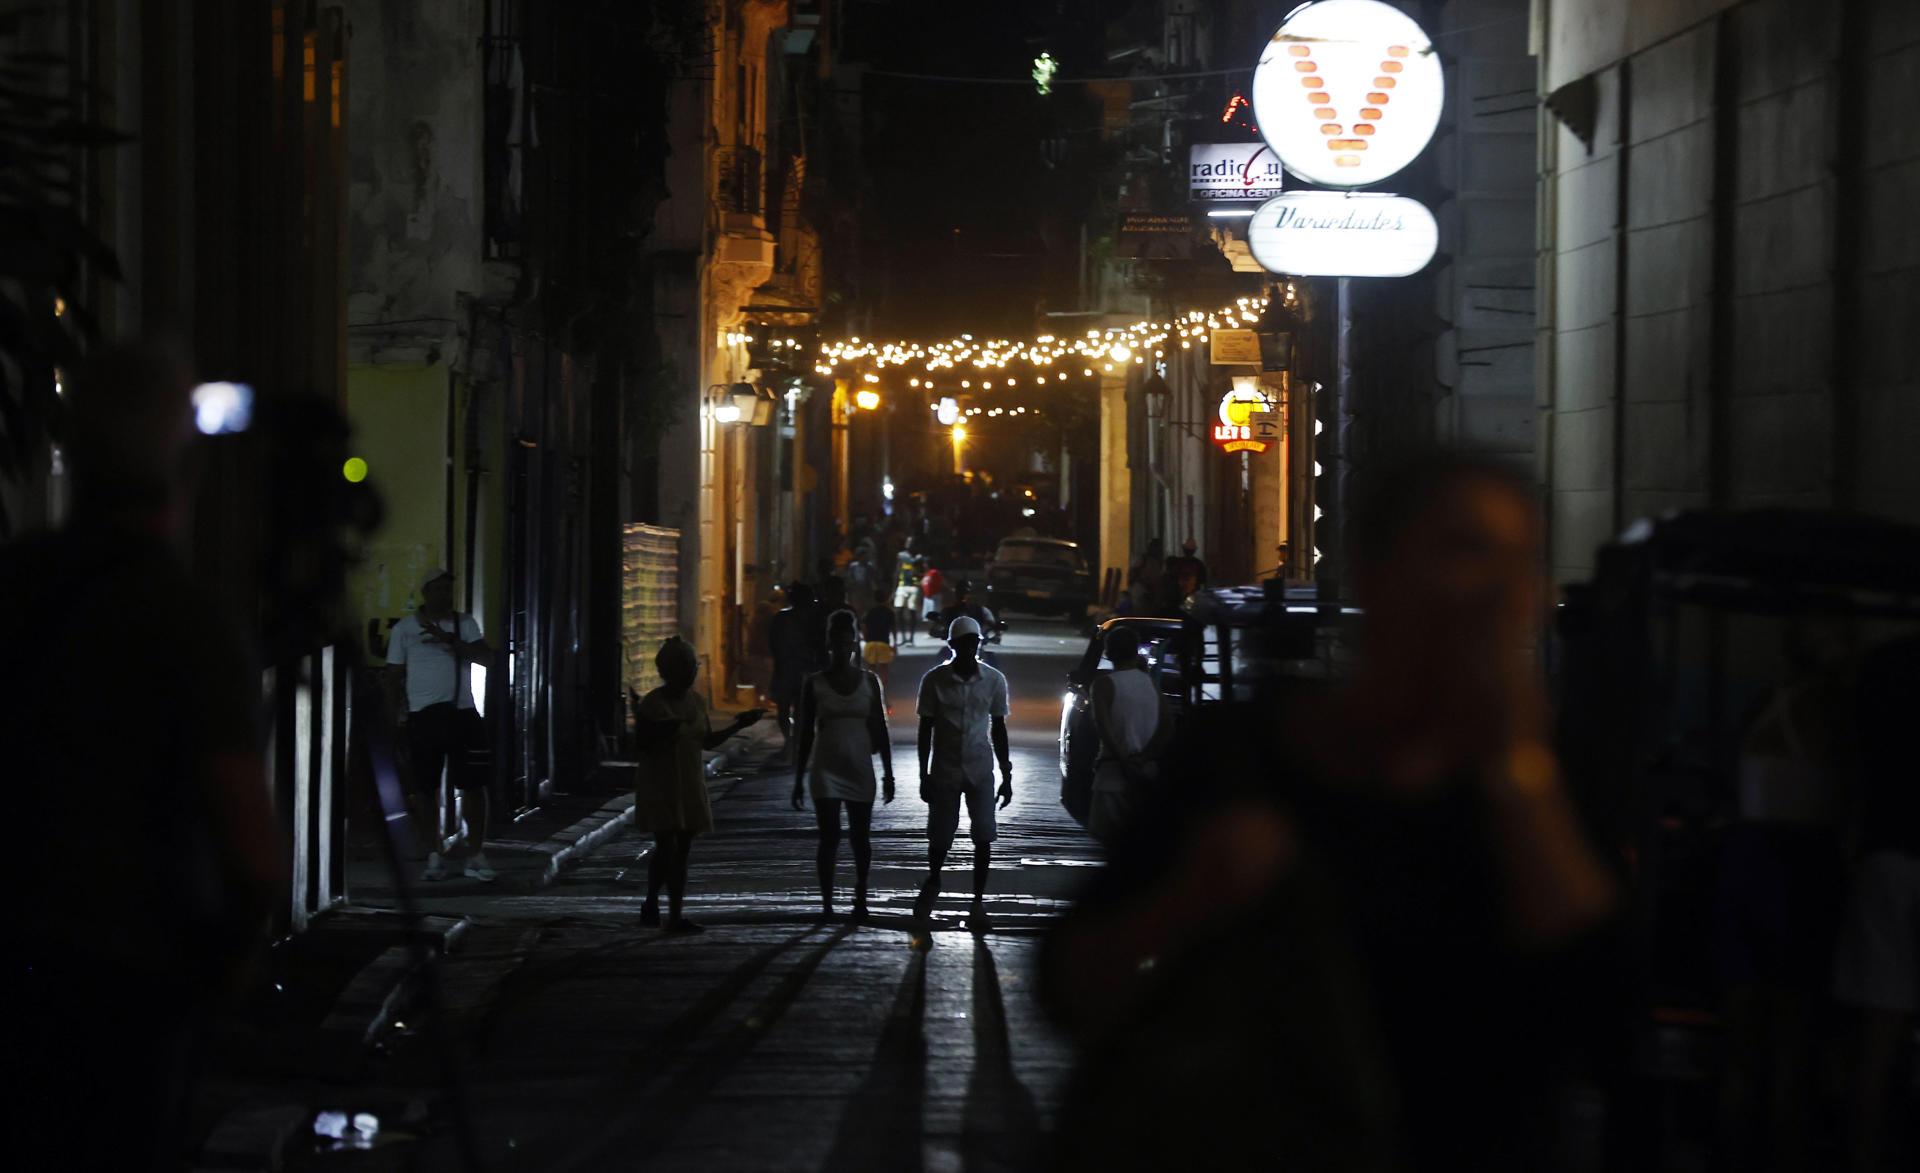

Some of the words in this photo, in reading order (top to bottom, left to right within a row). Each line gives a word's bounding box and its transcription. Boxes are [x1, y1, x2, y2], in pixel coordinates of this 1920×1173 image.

[1288, 45, 1409, 167] V
[1200, 188, 1246, 198] OFICINA
[1274, 206, 1406, 231] Variedades
